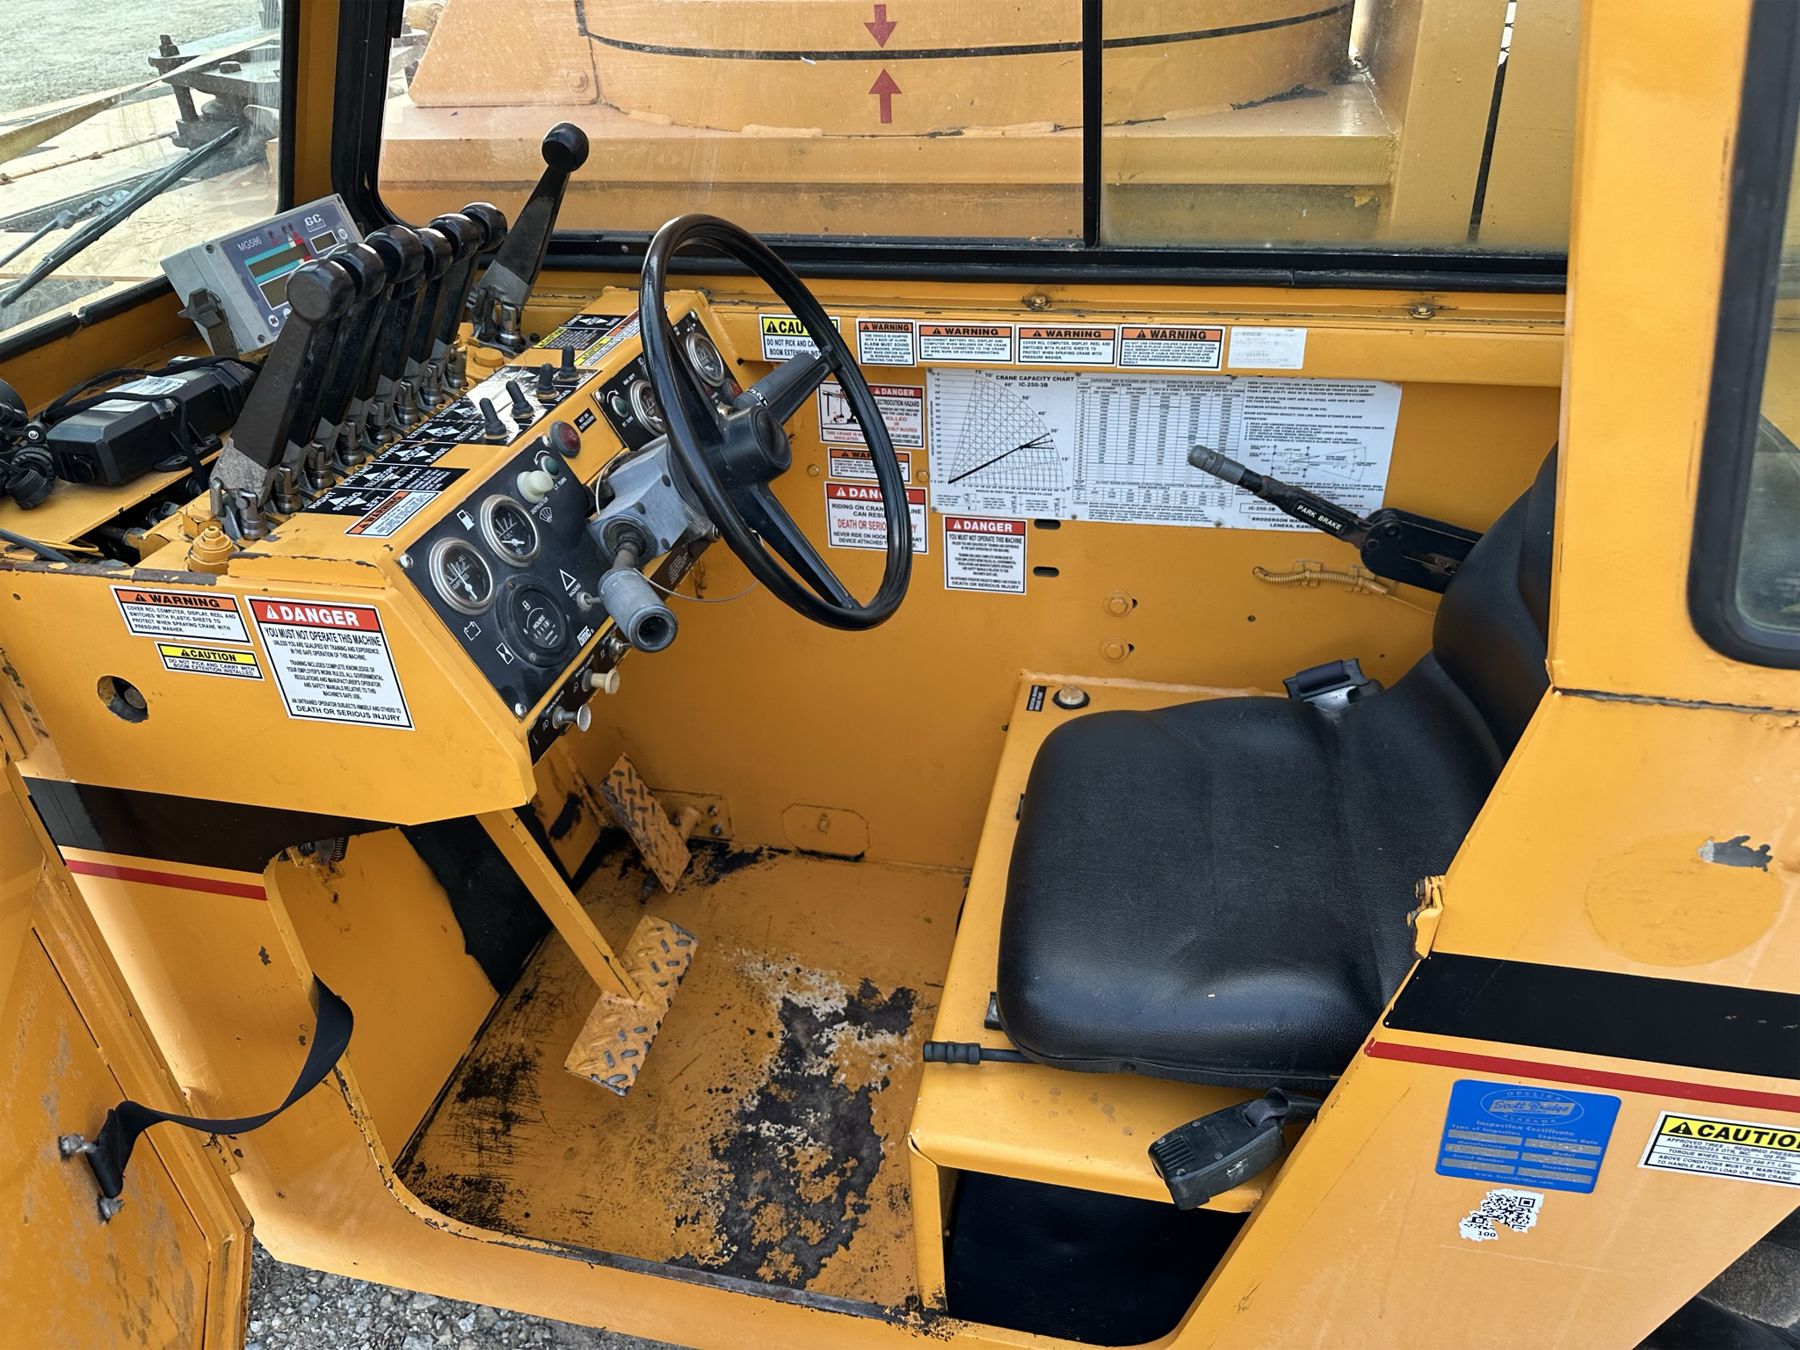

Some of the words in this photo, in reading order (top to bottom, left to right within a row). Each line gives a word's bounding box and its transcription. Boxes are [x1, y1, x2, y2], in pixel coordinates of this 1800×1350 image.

[237, 236, 262, 252] MG586
[871, 323, 910, 331] WARNING
[944, 327, 999, 336] WARNING
[1045, 330, 1102, 338] WARNING
[1150, 330, 1207, 340] WARNING
[767, 338, 774, 346] DO
[785, 339, 796, 347] PICK
[769, 348, 783, 356] BOOM
[377, 442, 406, 463] LOWER
[400, 445, 426, 462] BOOM
[424, 447, 450, 463] RAISE
[364, 465, 399, 488] TELESCOPE
[390, 467, 423, 489] RETRACT
[308, 491, 337, 510] RIGHT
[332, 491, 363, 512] SWING
[360, 495, 386, 512] LEFT
[530, 496, 549, 515] DEFROSTER
[365, 496, 402, 523] WARNING
[1296, 504, 1317, 518] PARK
[1317, 514, 1343, 531] BRAKE
[837, 519, 857, 528] DEATH
[858, 520, 868, 529] OR
[963, 520, 1013, 533] DANGER
[568, 582, 582, 598] HAZARD
[148, 594, 221, 608] WARNING
[279, 605, 360, 627] DANGER
[532, 614, 546, 630] HOURS
[264, 627, 278, 638] YOU
[278, 628, 295, 640] MUST
[296, 630, 310, 641] NOT
[310, 632, 337, 643] OPERATE
[338, 634, 352, 644] THIS
[352, 634, 382, 646] MACHINE
[190, 649, 237, 662] CAUTION
[296, 705, 322, 714] DEATH
[336, 709, 371, 719] SERIOUS
[372, 713, 401, 722] INJURY
[1476, 1119, 1524, 1131] Inspection
[1526, 1125, 1575, 1137] Certificate
[1658, 1154, 1681, 1162] ABOVE
[1683, 1156, 1723, 1167] CONDITIONS
[1725, 1161, 1744, 1169] MUST
[1756, 1165, 1797, 1177] MAINTAINED
[1667, 1161, 1694, 1169] HANDLE
[1751, 1170, 1767, 1179] THIS
[1768, 1172, 1792, 1181] CRANE.
[1478, 1230, 1496, 1238] 100
